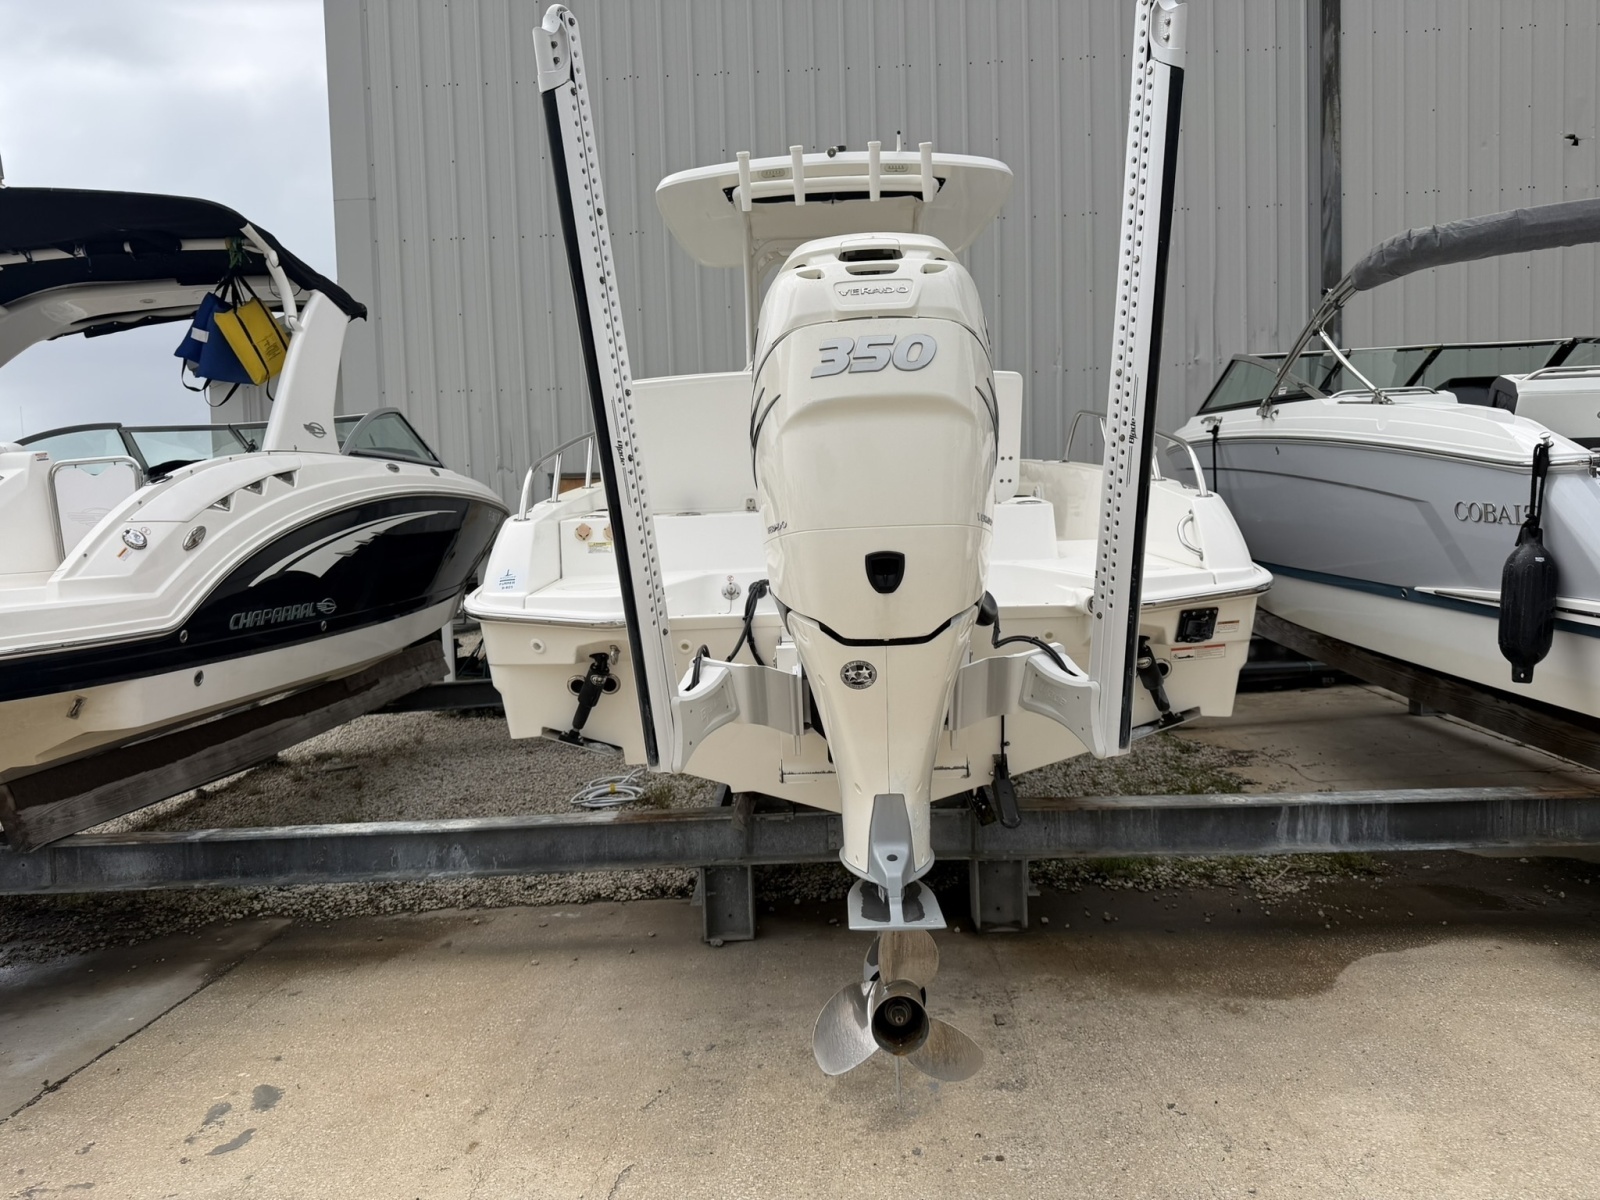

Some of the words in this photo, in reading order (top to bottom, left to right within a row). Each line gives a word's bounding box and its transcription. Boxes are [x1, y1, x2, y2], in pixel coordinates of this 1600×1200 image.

[838, 286, 909, 297] VERADO
[810, 333, 937, 379] 350
[229, 602, 316, 631] CHAPARRAL
